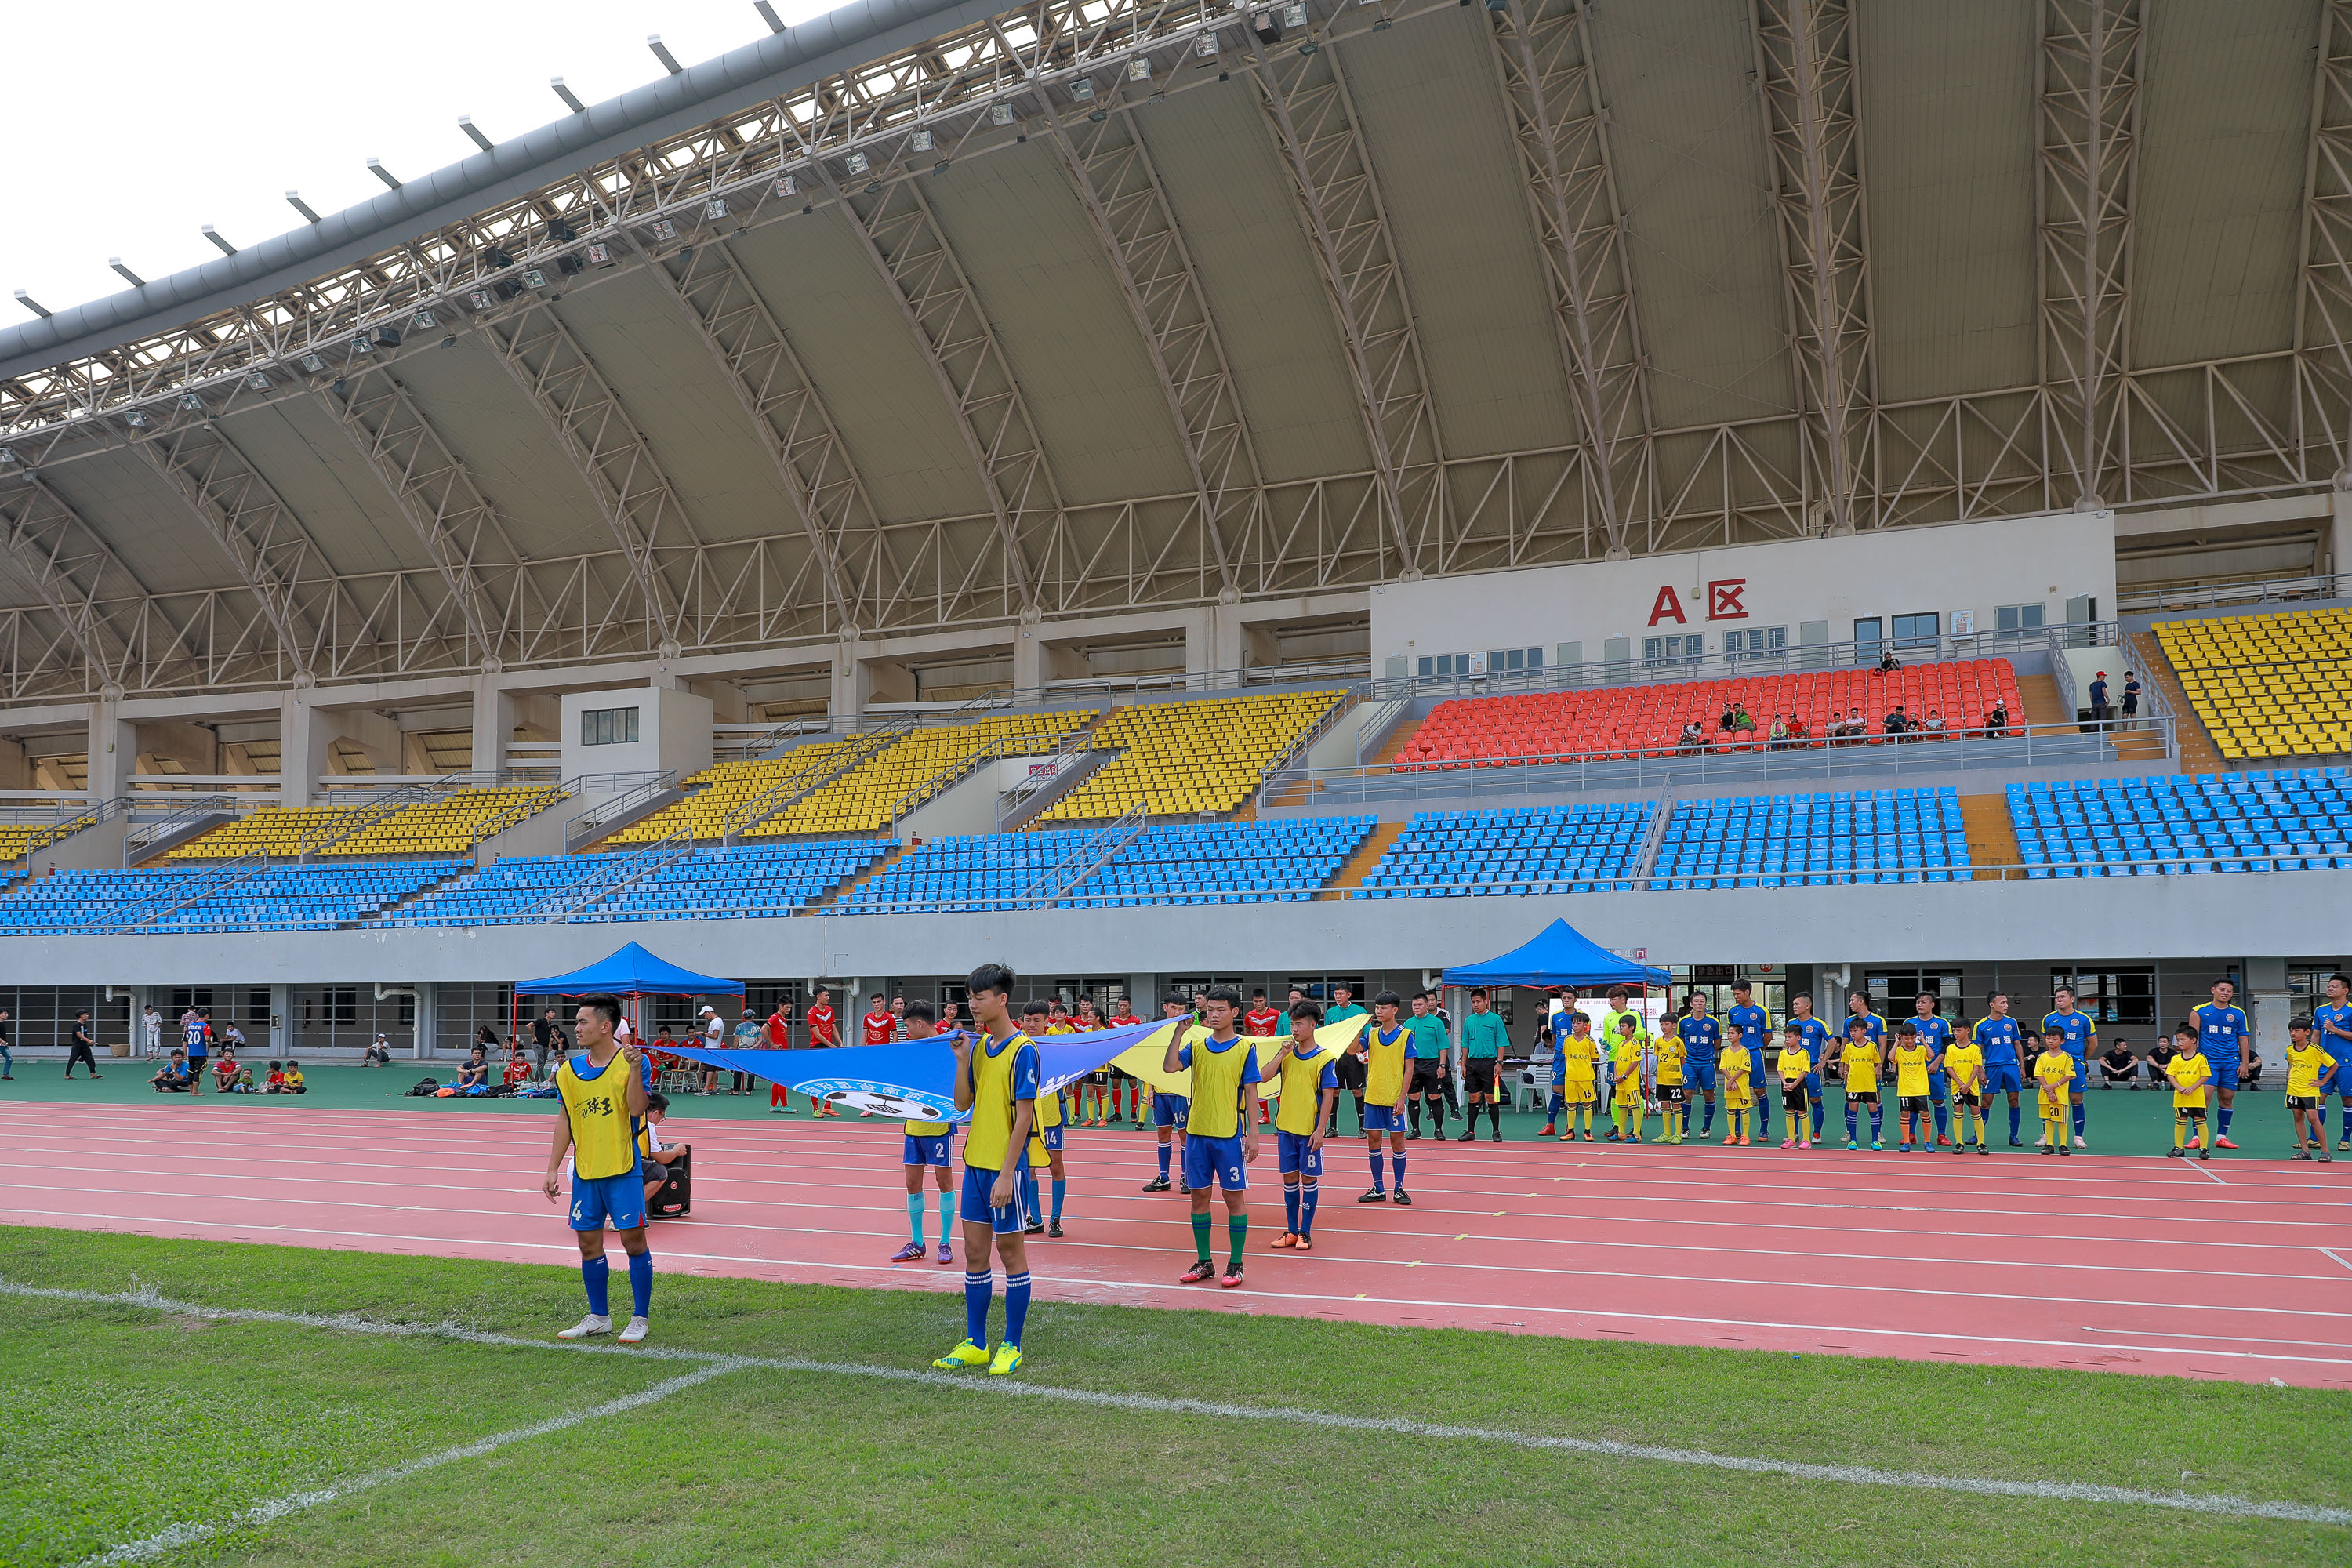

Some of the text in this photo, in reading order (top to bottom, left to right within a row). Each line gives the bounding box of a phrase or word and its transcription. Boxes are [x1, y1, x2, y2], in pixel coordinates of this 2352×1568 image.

[1607, 949, 1644, 958] 急出口
[2209, 1025, 2232, 1035] 南海
[188, 1031, 201, 1044] 20
[1991, 1036, 2012, 1045] 南海
[1660, 1053, 1669, 1062] 22
[1096, 1073, 1102, 1081] 11
[1671, 1088, 1682, 1099] 22
[1901, 1098, 1909, 1107] 11
[2050, 1106, 2060, 1116] 20
[1174, 1111, 1185, 1123] 16
[1392, 1115, 1399, 1127] 5
[1044, 1131, 1057, 1145] 14
[935, 1142, 945, 1158] 2
[1307, 1154, 1316, 1168] 8
[1229, 1167, 1240, 1182] 3
[572, 1200, 583, 1221] 4
